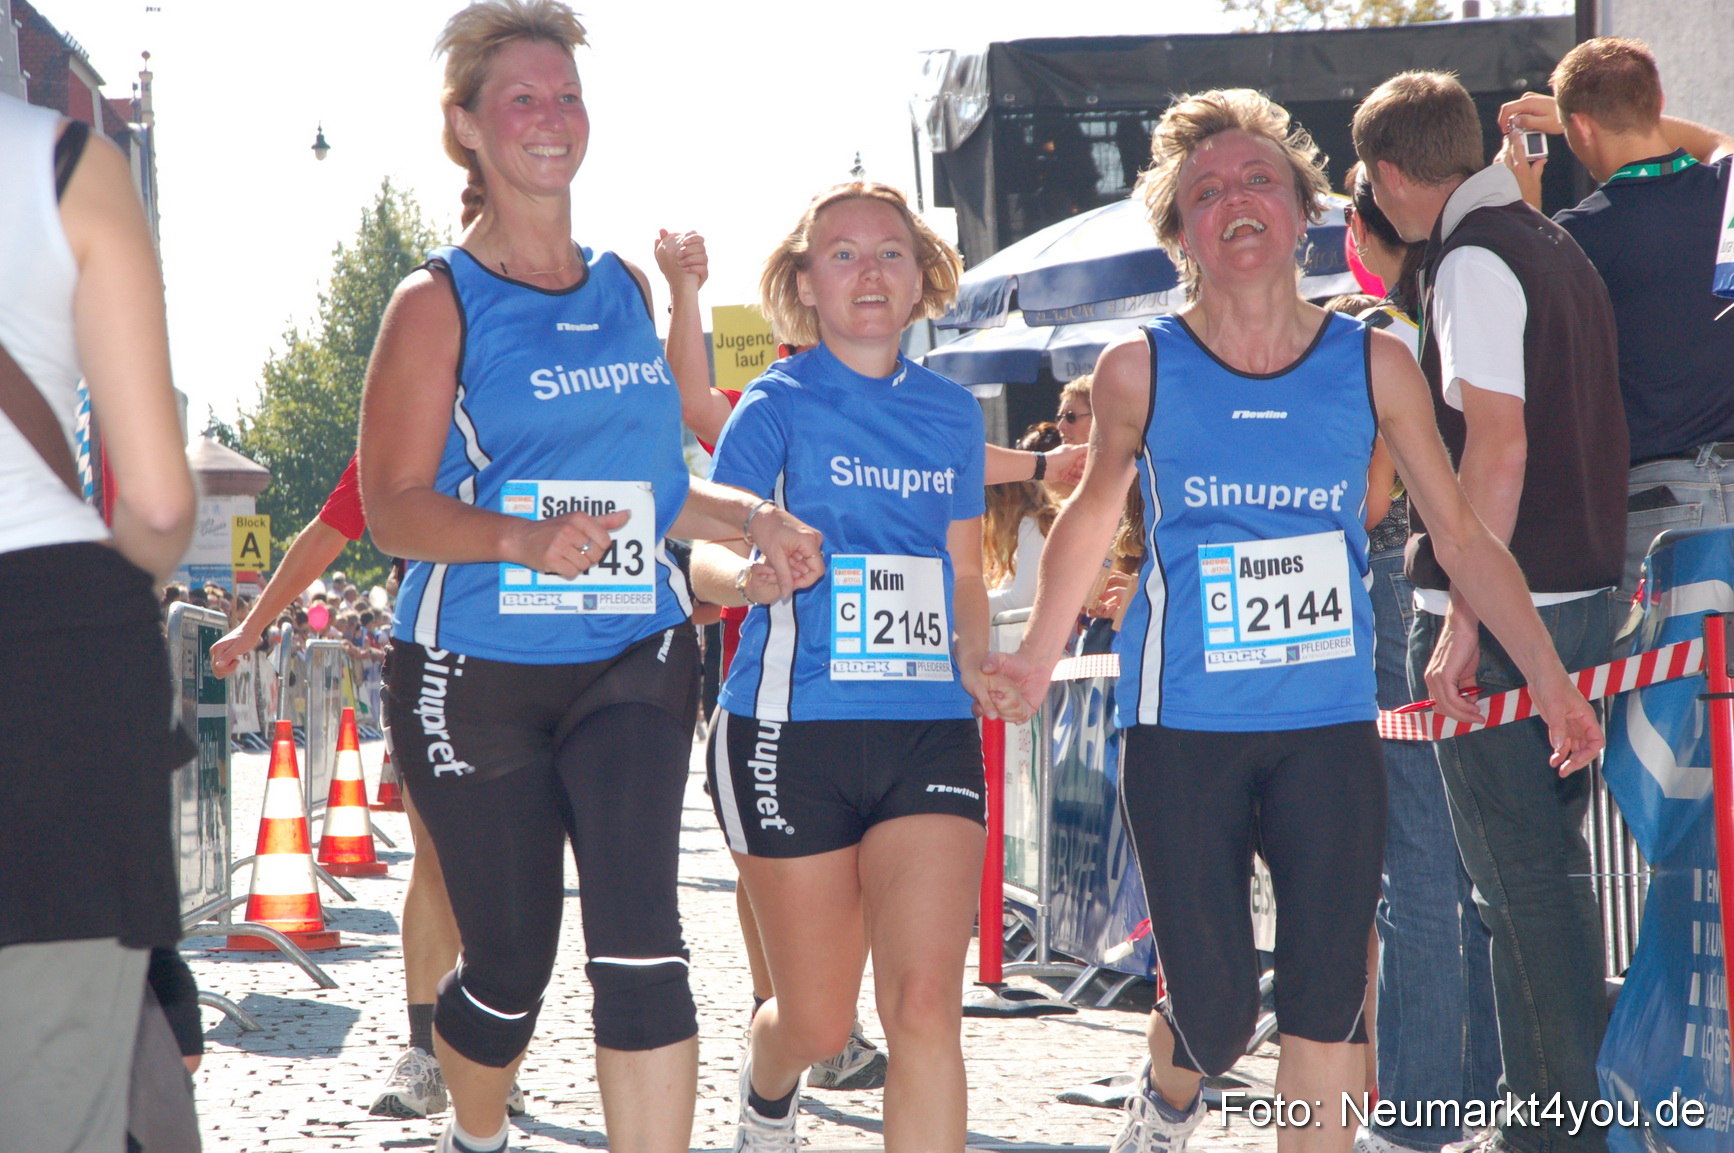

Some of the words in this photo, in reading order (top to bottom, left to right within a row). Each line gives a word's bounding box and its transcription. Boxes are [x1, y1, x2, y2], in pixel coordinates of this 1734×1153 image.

[716, 332, 774, 350] Jugend
[736, 351, 766, 367] lauf
[542, 496, 616, 518] Sabine
[237, 517, 266, 527] Block
[240, 532, 261, 558] A
[1239, 554, 1304, 580] Agnes
[870, 569, 904, 591] Kim
[503, 594, 562, 606] BOCK
[599, 594, 653, 604] PFLEIDERER
[1211, 592, 1228, 611] C
[840, 602, 856, 621] C
[1246, 587, 1343, 633] 2144
[873, 609, 942, 646] 2145
[1301, 637, 1352, 654] PFLEIDERER
[1208, 648, 1267, 665] BOCK
[833, 661, 890, 673] BOCK
